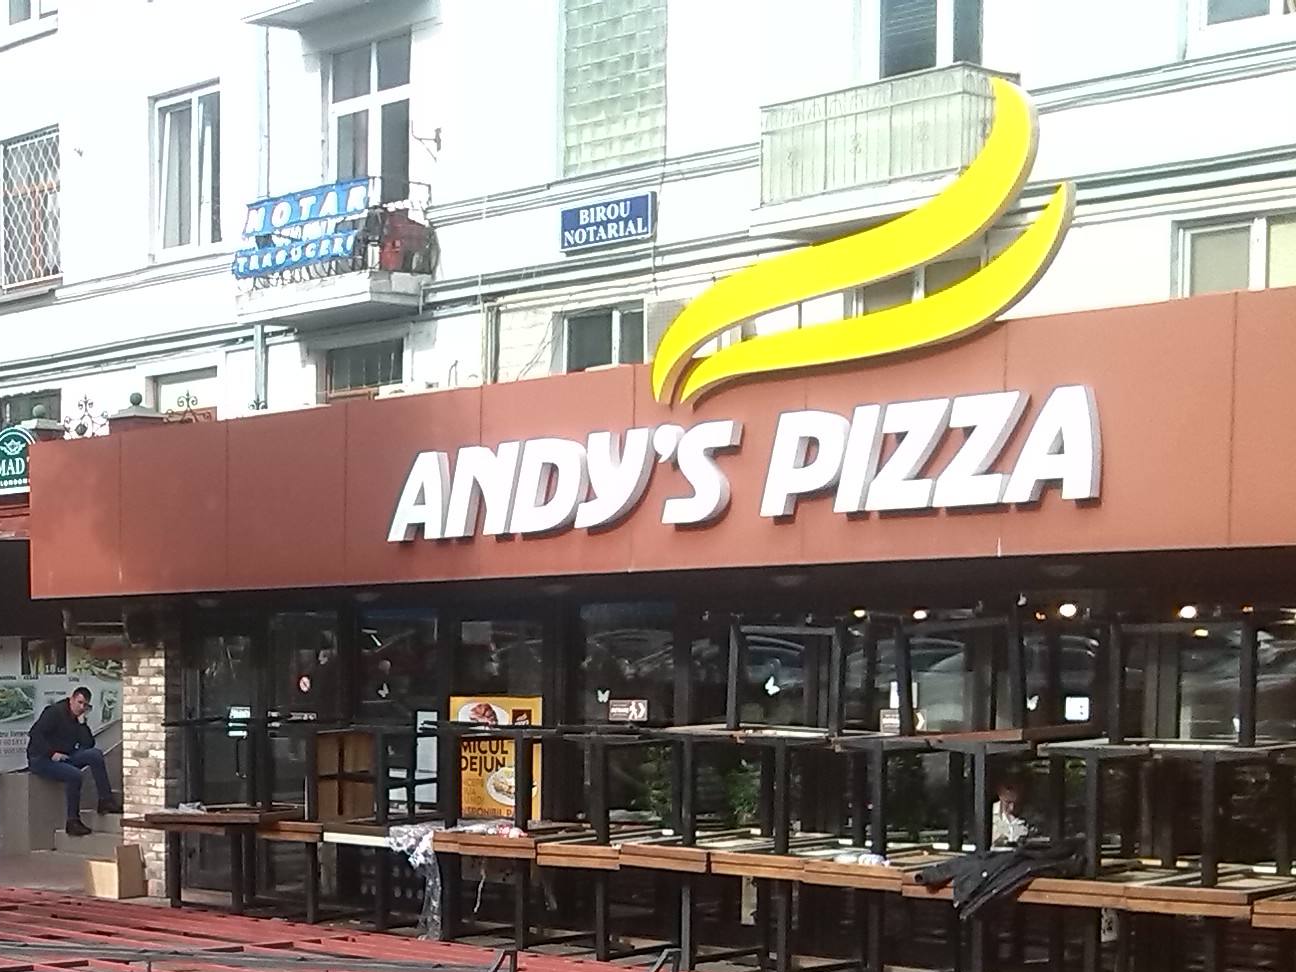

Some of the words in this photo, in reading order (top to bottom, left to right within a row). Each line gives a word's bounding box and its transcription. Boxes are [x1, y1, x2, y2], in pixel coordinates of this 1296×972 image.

[245, 186, 367, 234] NOTAR
[579, 201, 631, 225] BIROU
[564, 218, 648, 246] NOTARIAL
[236, 235, 355, 272] TRADUCERI
[386, 420, 743, 543] ANDY'S
[760, 385, 1102, 518] PIZZA
[0, 478, 29, 487] LONDON
[461, 739, 508, 755] MICUL
[460, 756, 506, 776] DEJUN
